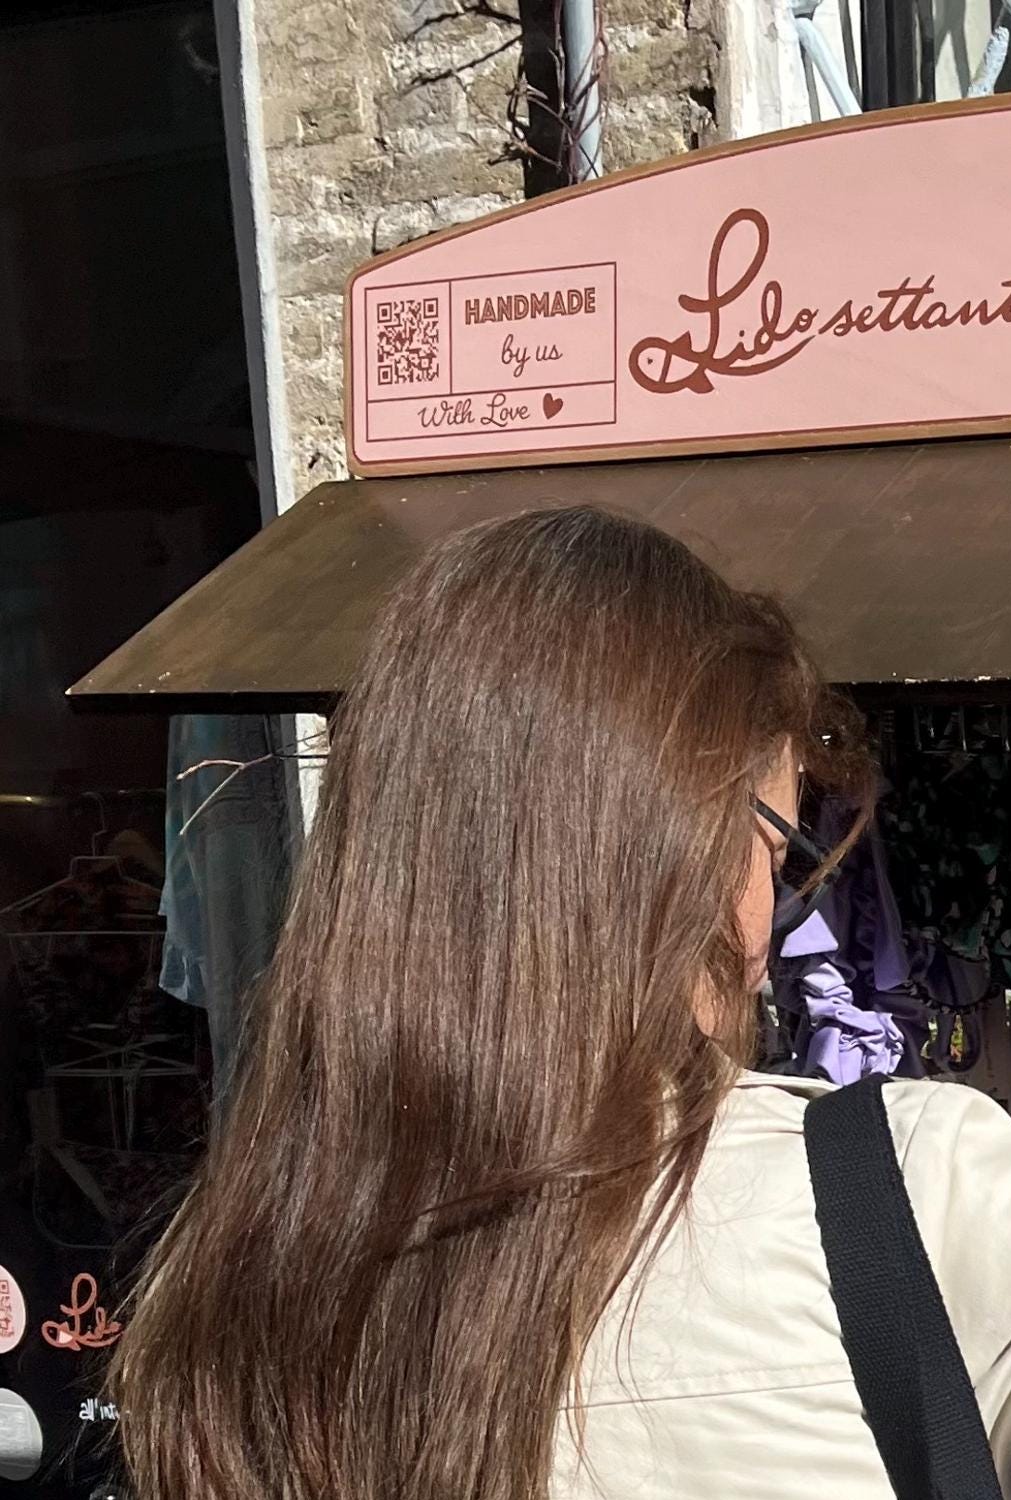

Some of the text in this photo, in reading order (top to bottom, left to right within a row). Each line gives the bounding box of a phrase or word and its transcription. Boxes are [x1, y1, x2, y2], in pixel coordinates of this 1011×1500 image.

[463, 285, 597, 326] HANDMADE
[500, 333, 564, 378] by us
[416, 391, 532, 429] With Love
